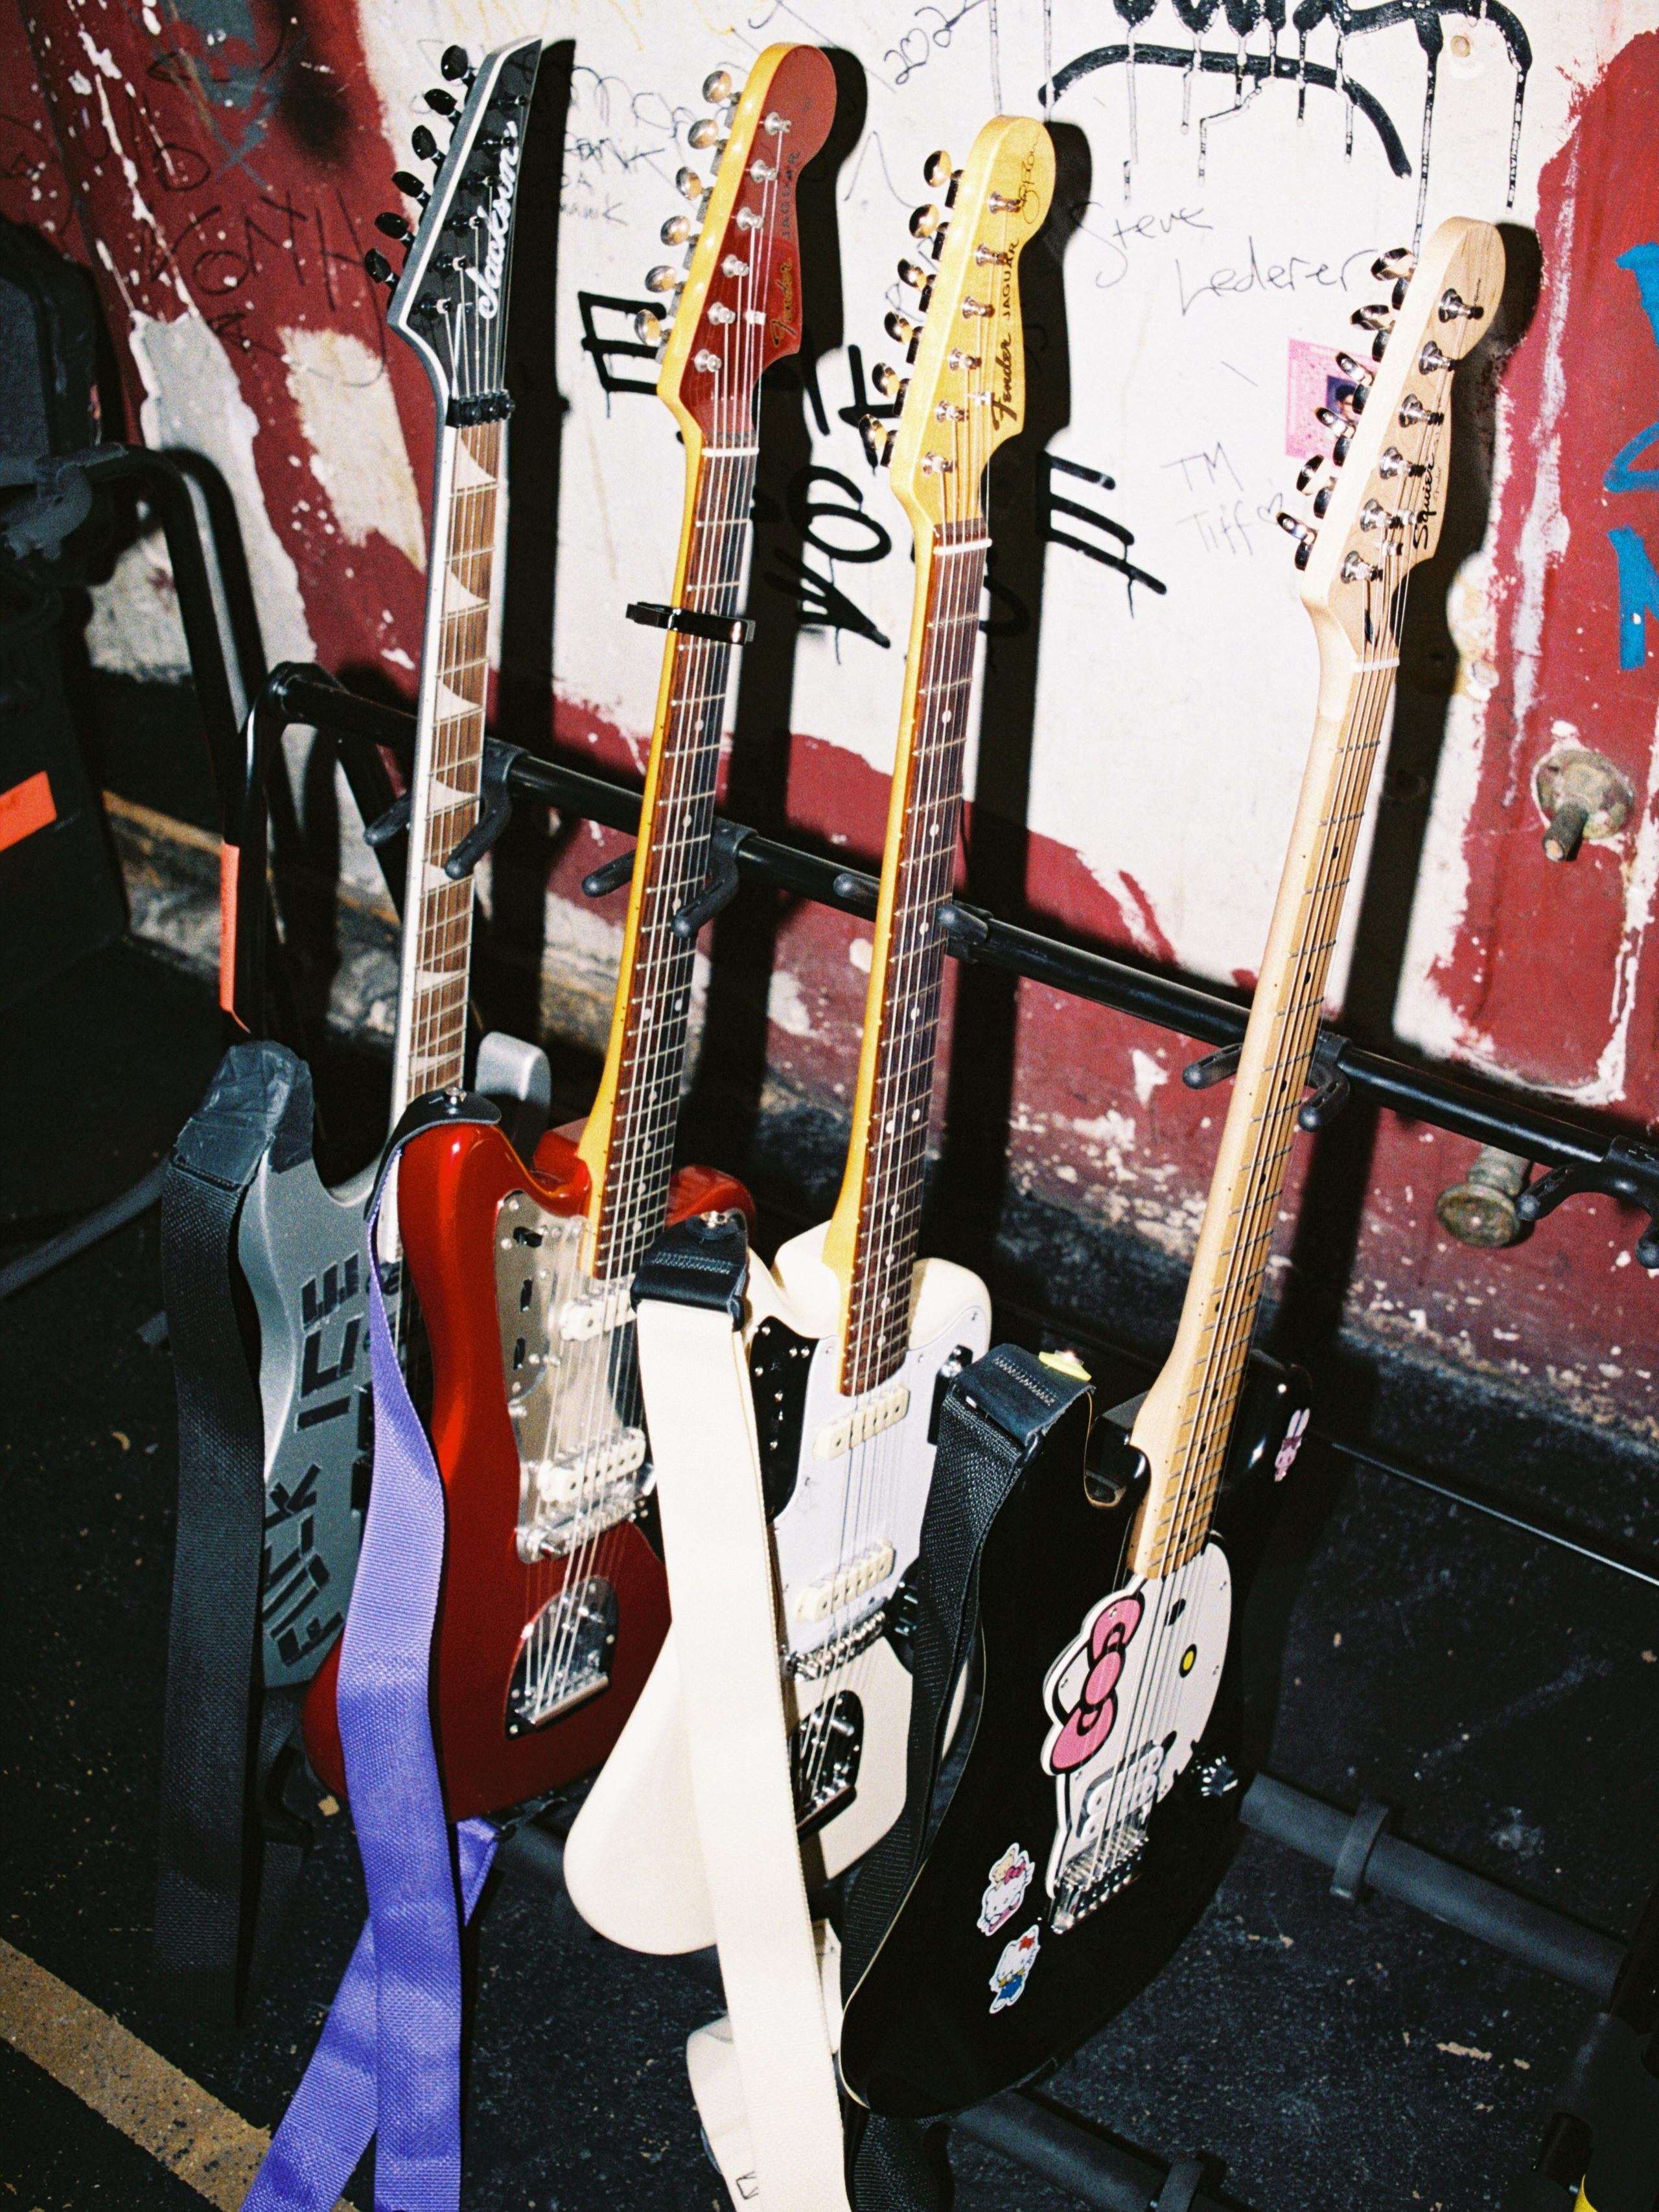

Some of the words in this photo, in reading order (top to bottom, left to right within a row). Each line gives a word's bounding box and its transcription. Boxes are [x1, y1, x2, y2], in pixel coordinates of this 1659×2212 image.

[465, 121, 519, 319] Jackson
[778, 151, 801, 240] JAGUAR
[1001, 239, 1020, 321] JAGUAR
[1071, 201, 1214, 289] Steve
[1175, 234, 1379, 317] Lederer
[771, 257, 797, 347] Fender
[990, 333, 1017, 431] Fender
[1412, 452, 1437, 550] Squier
[294, 1251, 364, 1432] ICE
[262, 1463, 344, 1667] FUCK
